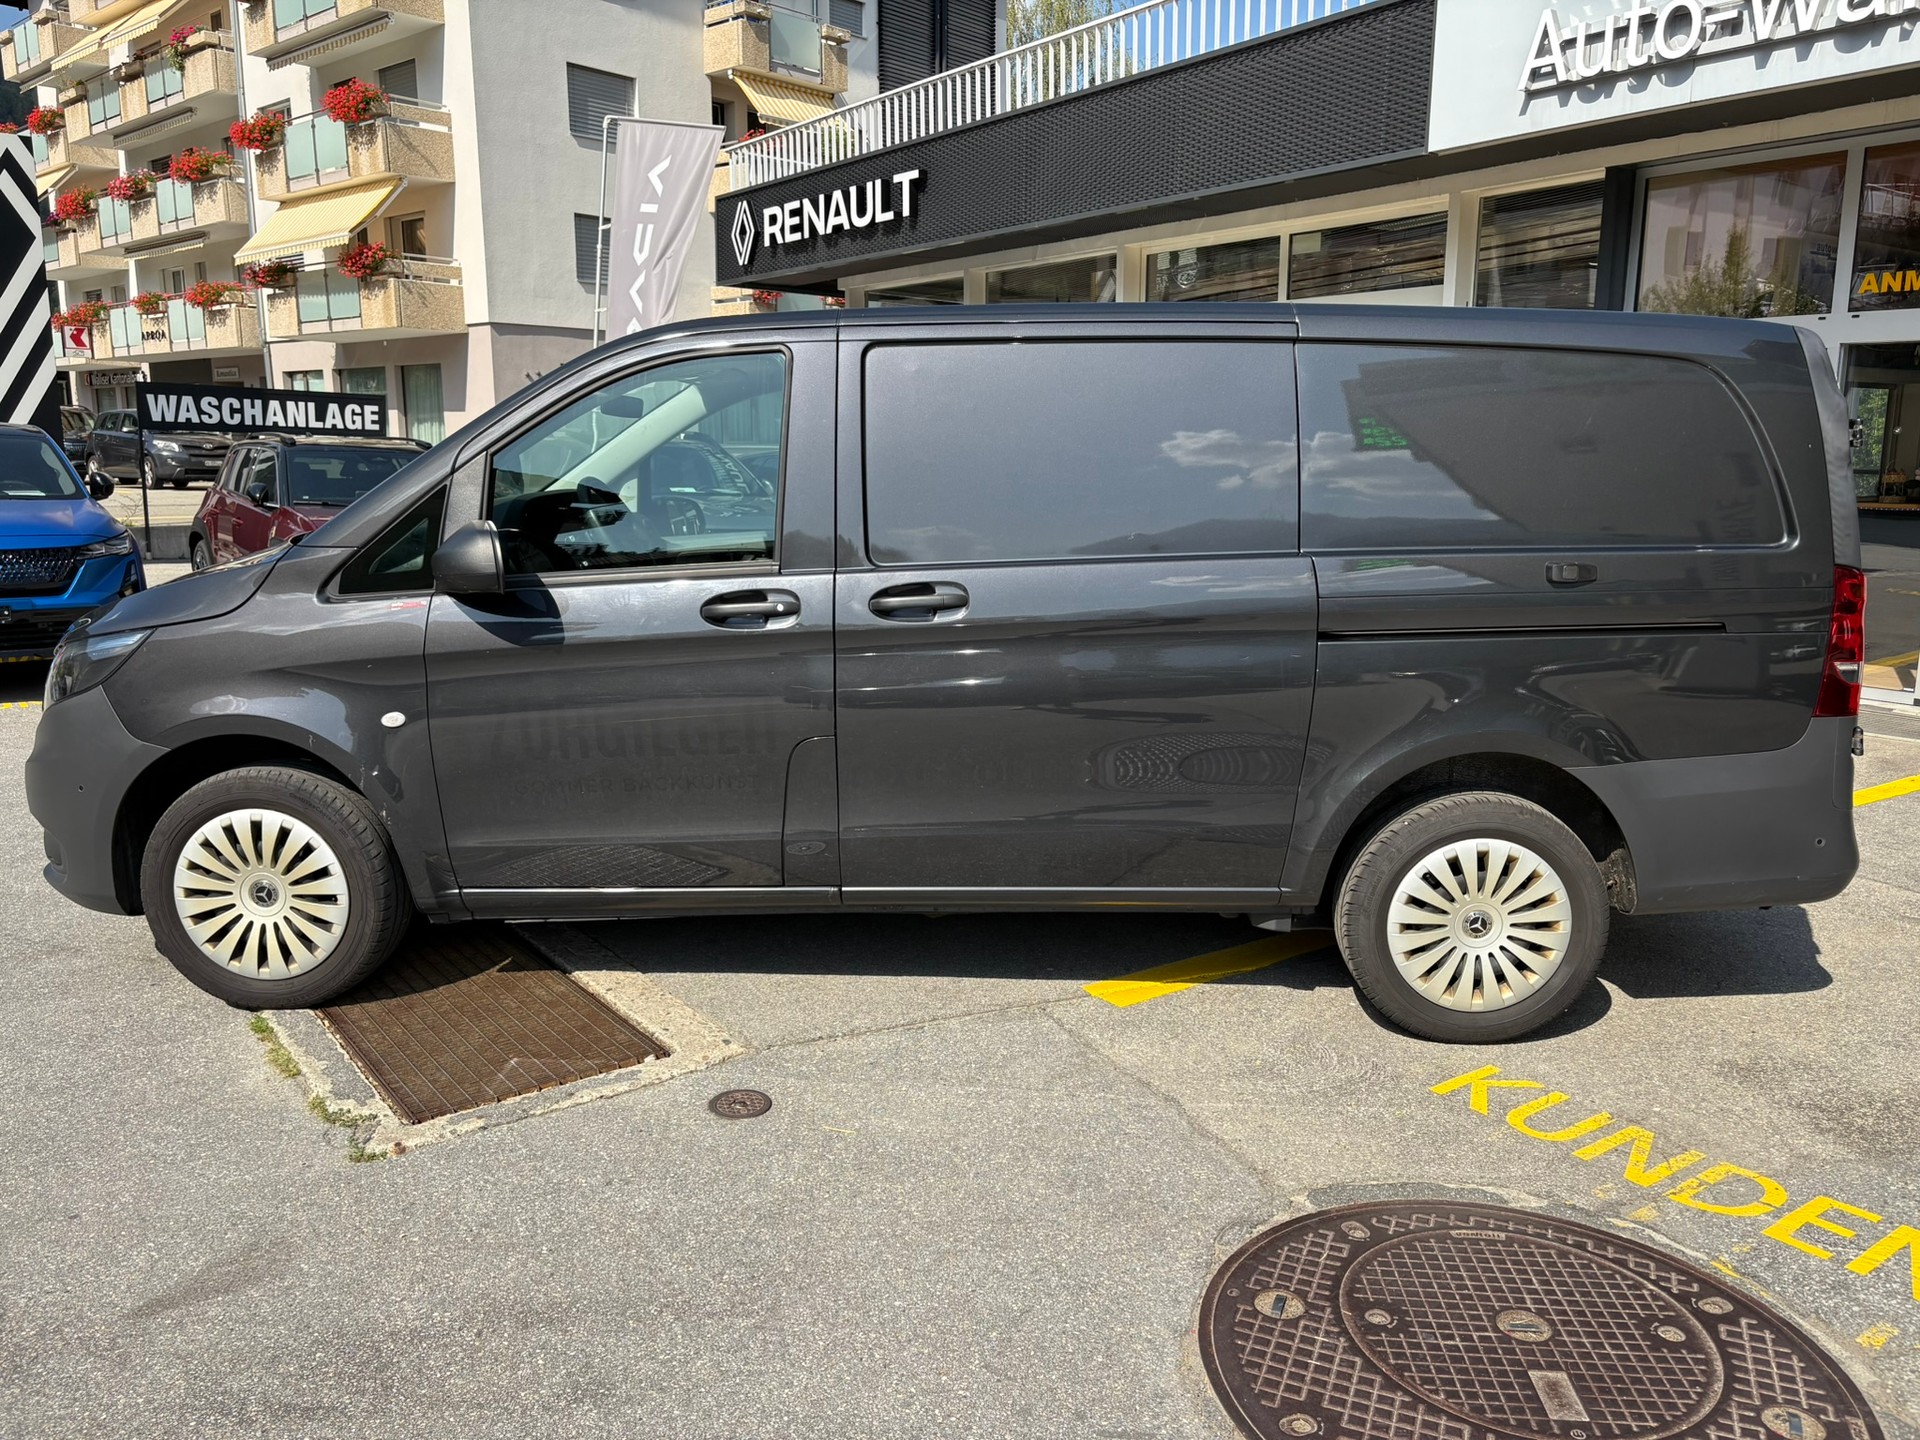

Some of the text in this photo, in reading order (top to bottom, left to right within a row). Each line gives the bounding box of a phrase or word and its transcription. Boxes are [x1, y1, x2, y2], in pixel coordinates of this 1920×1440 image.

[1517, 0, 1920, 92] Auto-W
[762, 169, 920, 248] RENAULT
[146, 393, 380, 430] WASCHANLAGE
